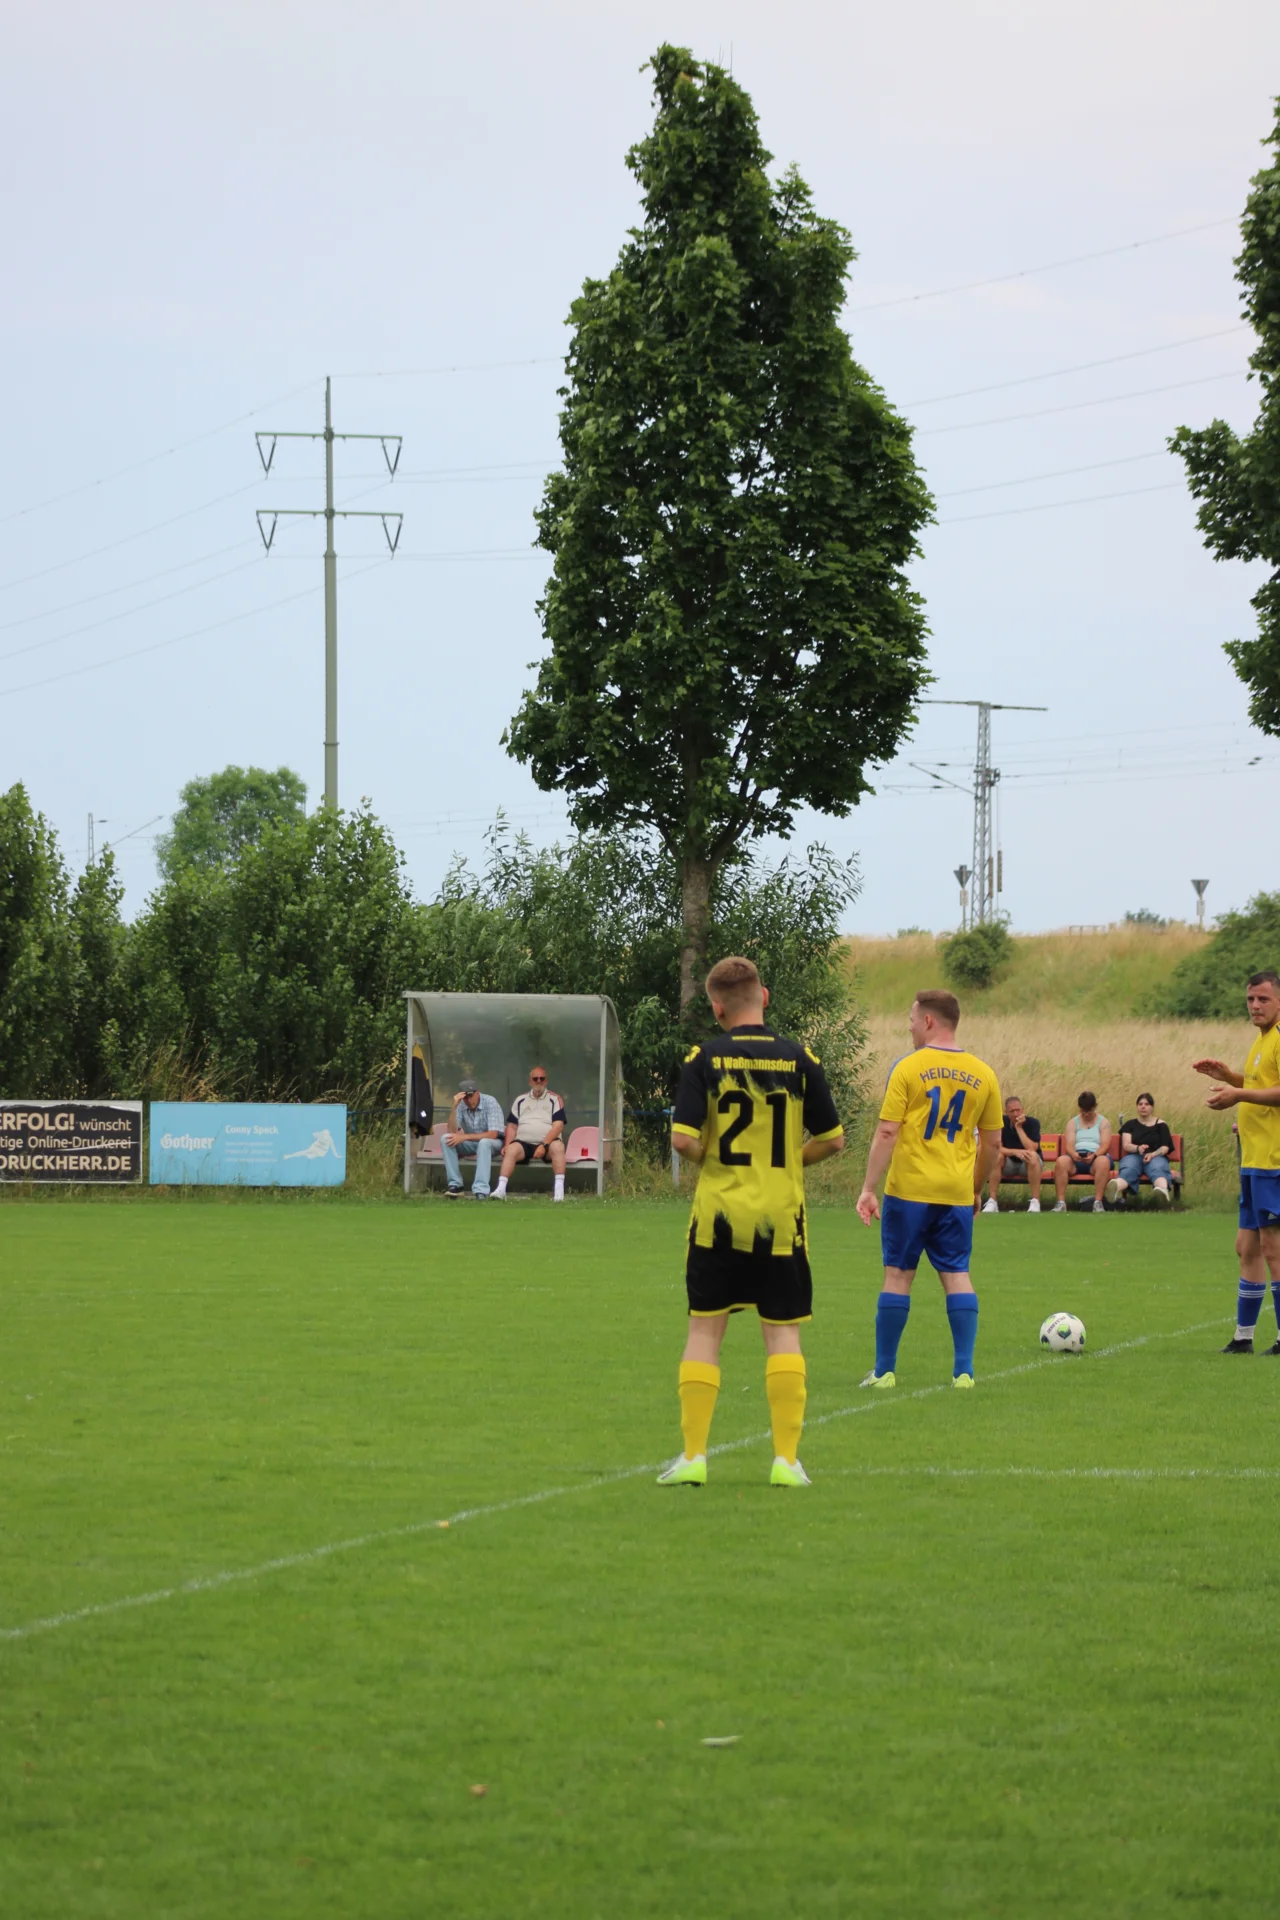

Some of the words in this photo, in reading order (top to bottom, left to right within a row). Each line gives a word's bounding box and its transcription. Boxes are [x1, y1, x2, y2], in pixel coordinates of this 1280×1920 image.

[723, 1056, 797, 1073] Waßmannsdorf
[919, 1067, 982, 1091] HEIDESEE
[0, 1113, 75, 1131] RFOLG!
[80, 1118, 132, 1131] wünscht
[923, 1086, 967, 1144] 14
[717, 1090, 787, 1168] 21
[28, 1136, 131, 1149] Online-Druckerei
